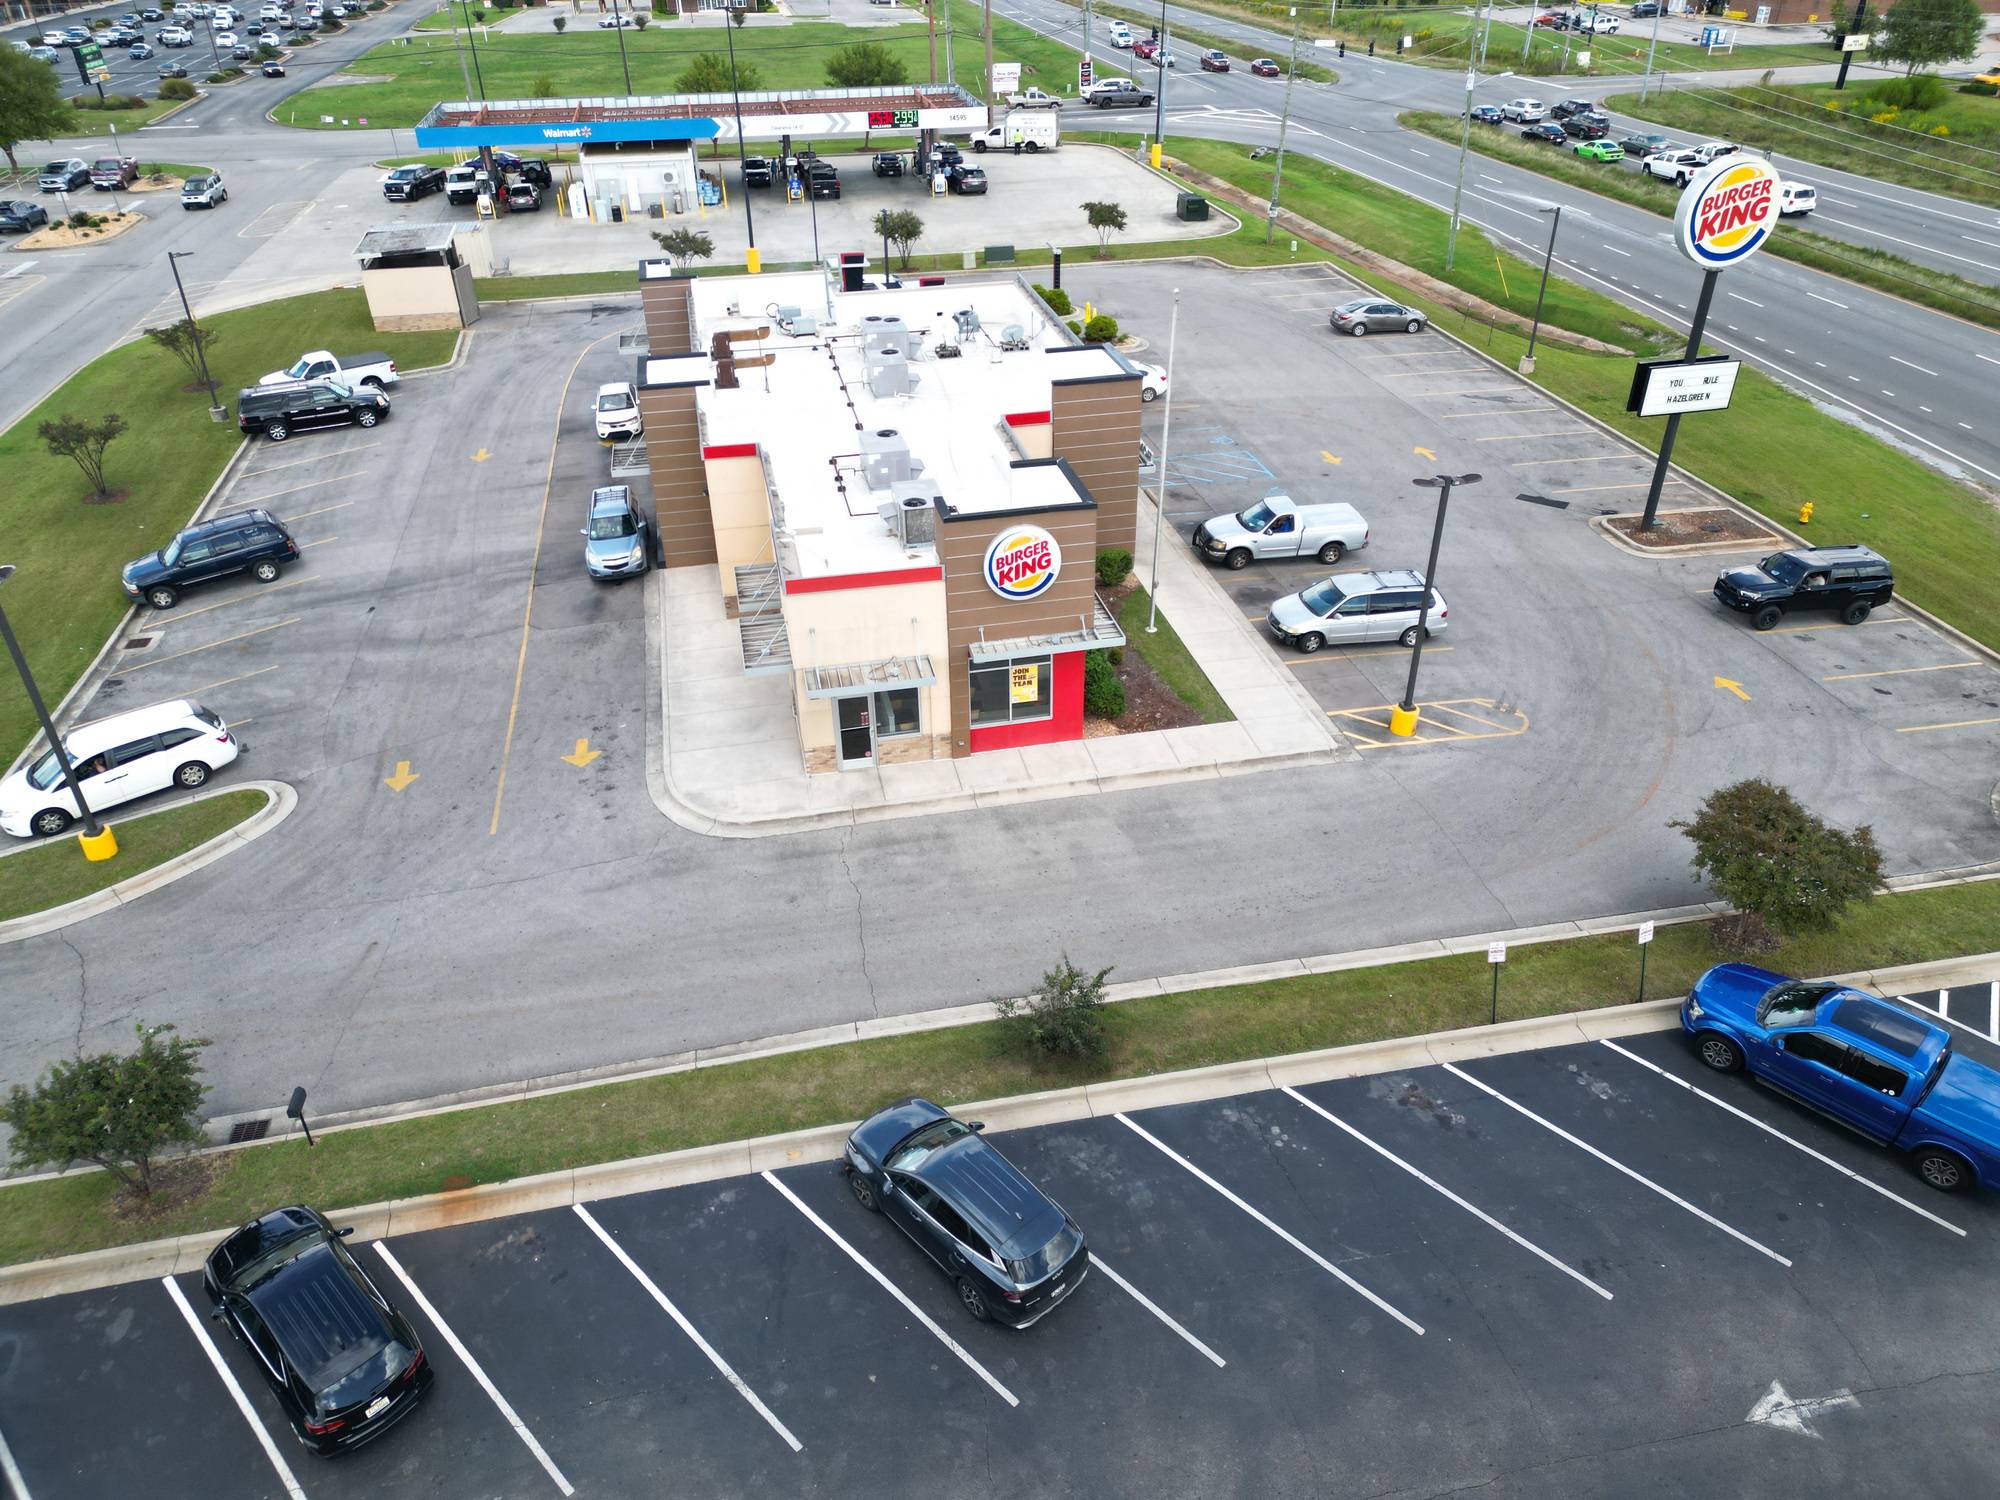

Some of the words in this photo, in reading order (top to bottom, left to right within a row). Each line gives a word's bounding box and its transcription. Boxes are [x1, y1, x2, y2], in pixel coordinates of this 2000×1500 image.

[543, 128, 581, 138] Walmart
[1700, 179, 1773, 216] BURGER
[1696, 196, 1771, 242] KING
[1670, 379, 1684, 387] YOU
[1703, 376, 1719, 384] RULE
[995, 540, 1049, 570] BURGER
[998, 552, 1051, 587] KING
[1012, 667, 1029, 675] JOIN
